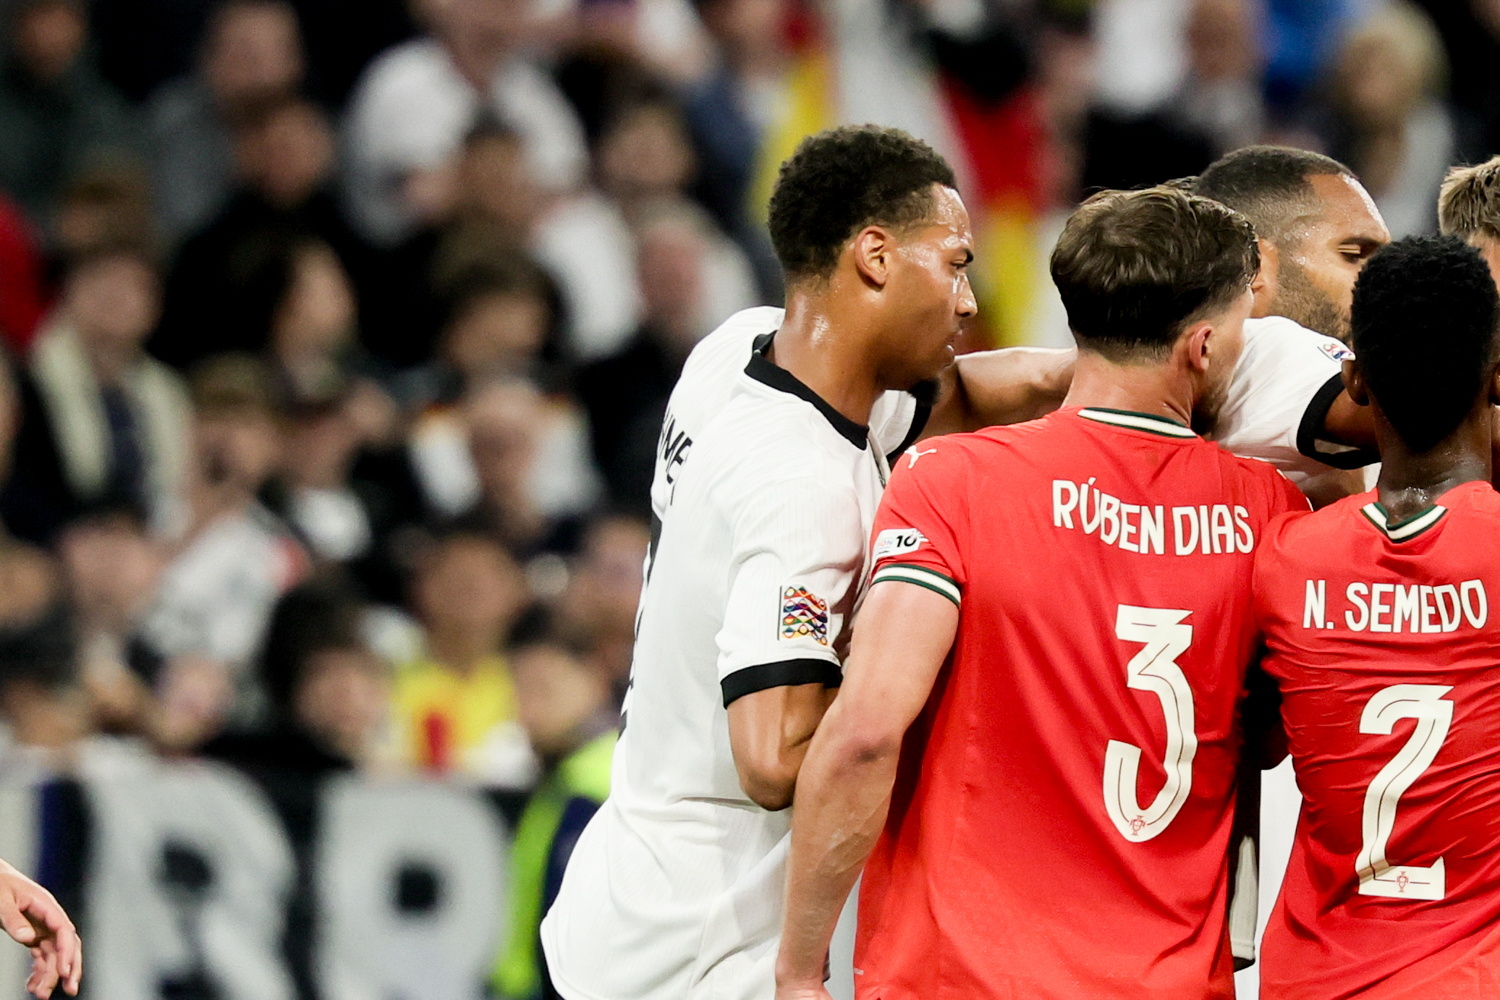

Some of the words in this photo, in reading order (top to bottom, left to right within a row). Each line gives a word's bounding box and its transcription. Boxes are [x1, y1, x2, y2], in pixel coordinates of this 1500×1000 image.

[1052, 476, 1165, 555] RÚBEN
[1171, 504, 1255, 556] DIAS
[1303, 579, 1334, 630] N.
[1344, 579, 1489, 634] SEMEDO
[1103, 604, 1198, 843] 3
[1354, 683, 1447, 902] 2
